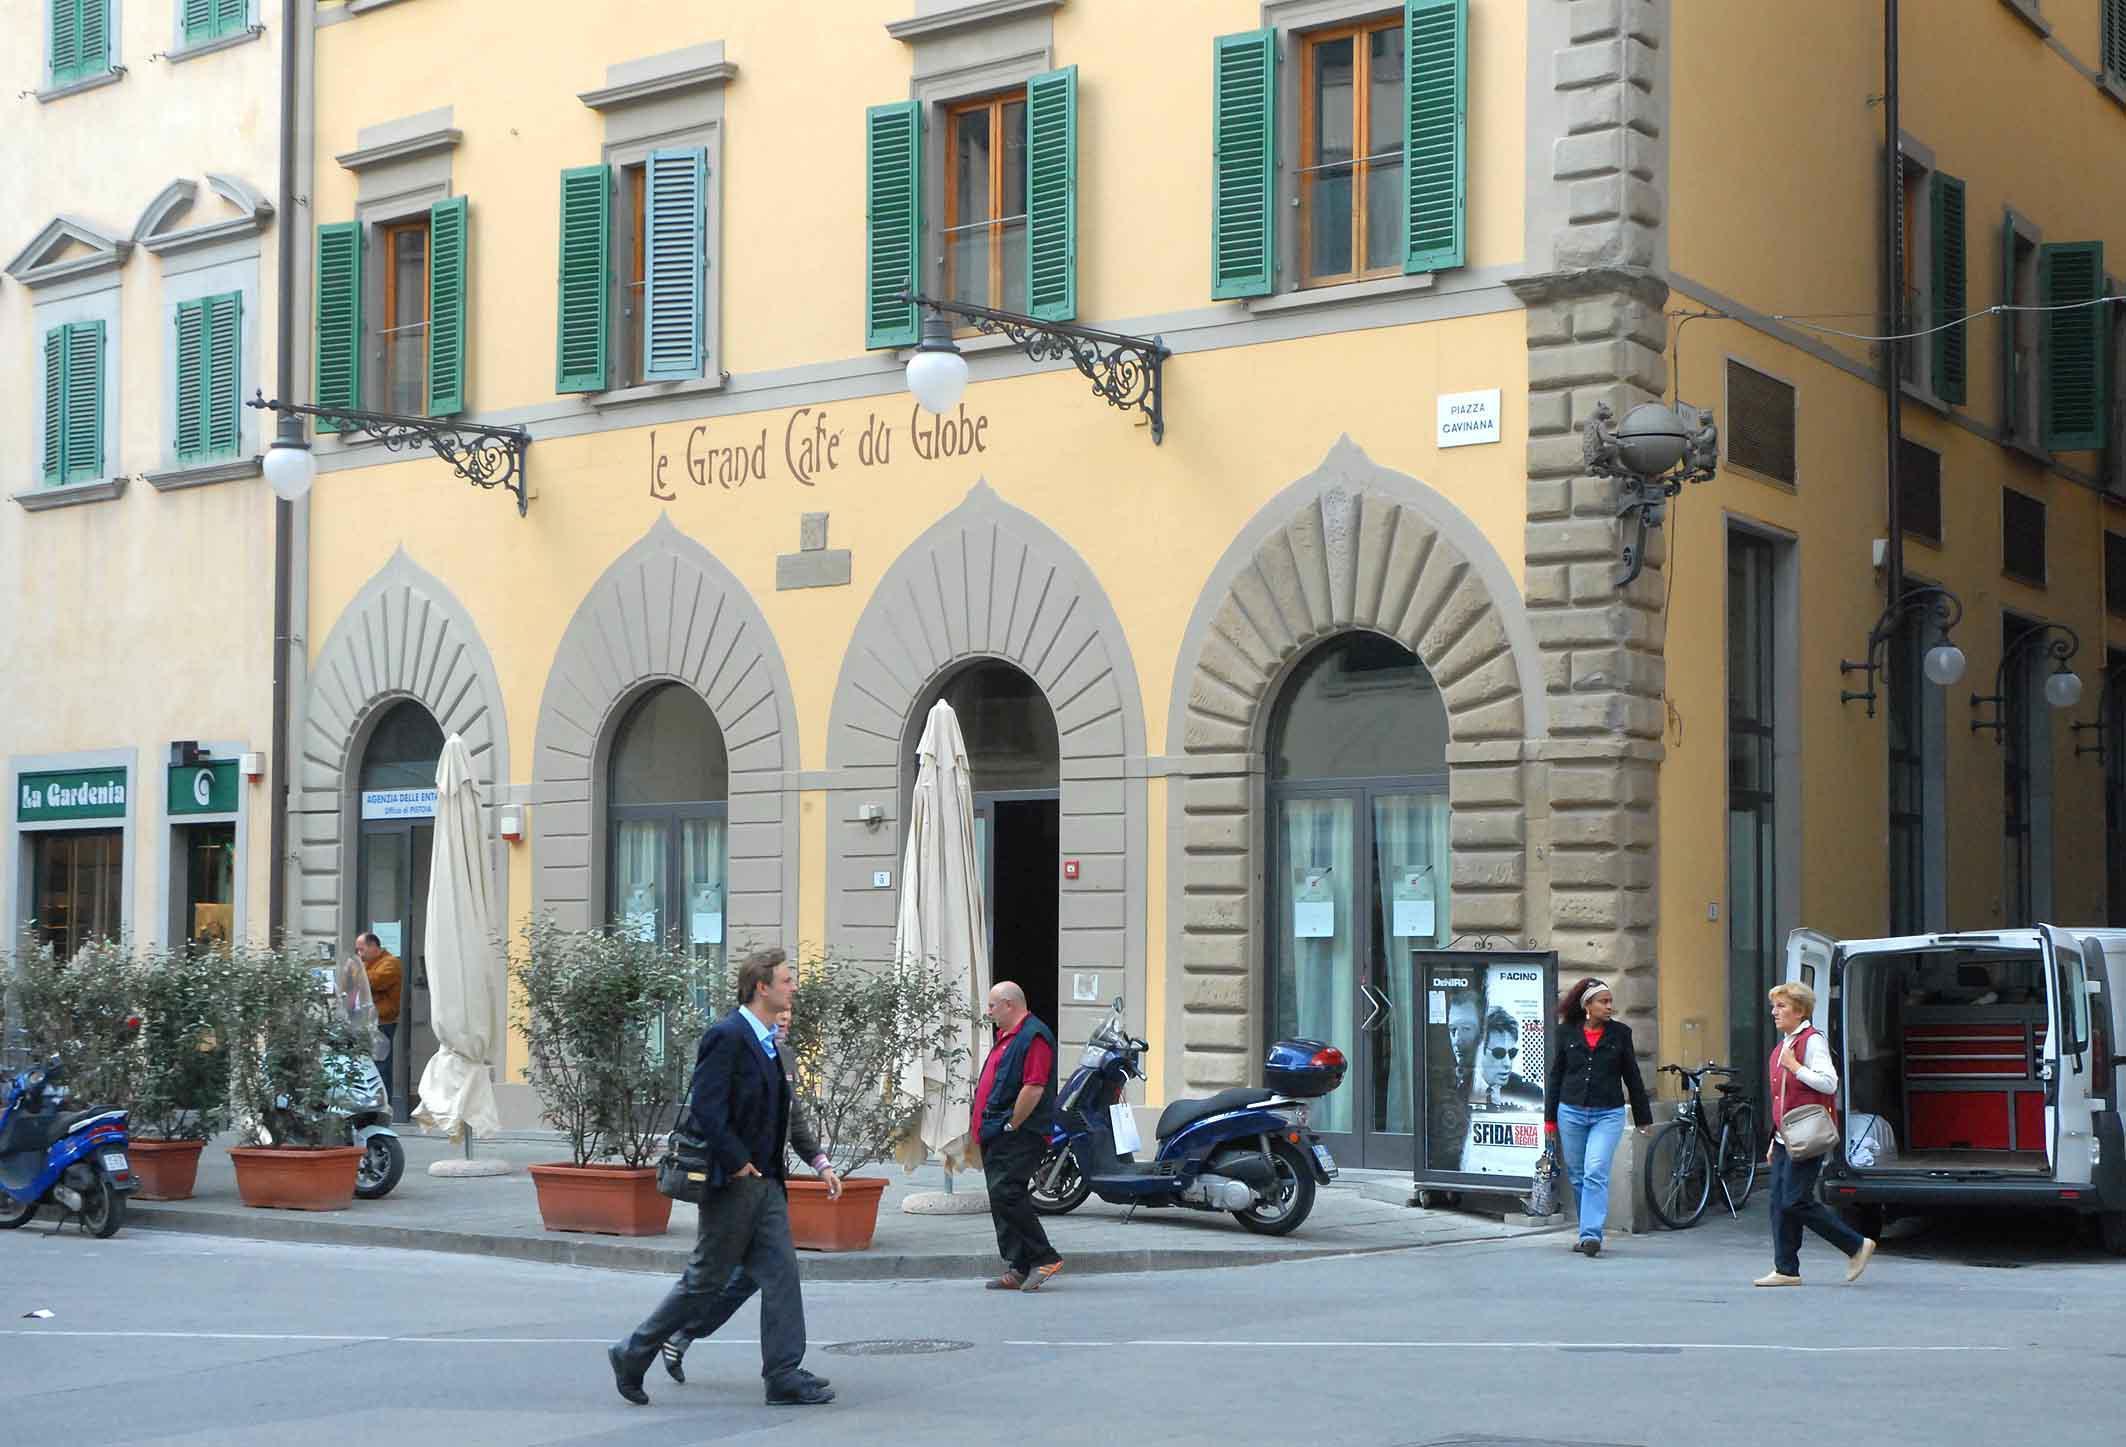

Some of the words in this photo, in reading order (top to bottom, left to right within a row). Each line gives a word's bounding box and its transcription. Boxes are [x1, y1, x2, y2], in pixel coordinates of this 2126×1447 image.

[1450, 403, 1485, 415] PIAZZA
[1442, 419, 1493, 433] GAVINANA
[650, 431, 676, 501] Le
[686, 425, 767, 489] Grand
[785, 408, 844, 487] Café
[858, 412, 891, 466] du
[911, 402, 988, 460] Globe
[22, 785, 42, 808] La
[47, 781, 125, 807] Gardenia
[367, 793, 397, 804] AGENZIA
[399, 792, 419, 802] DELLE
[1500, 972, 1537, 981] PACINO
[1473, 1122, 1513, 1145] SFIDA
[1514, 1125, 1538, 1137] SENZA
